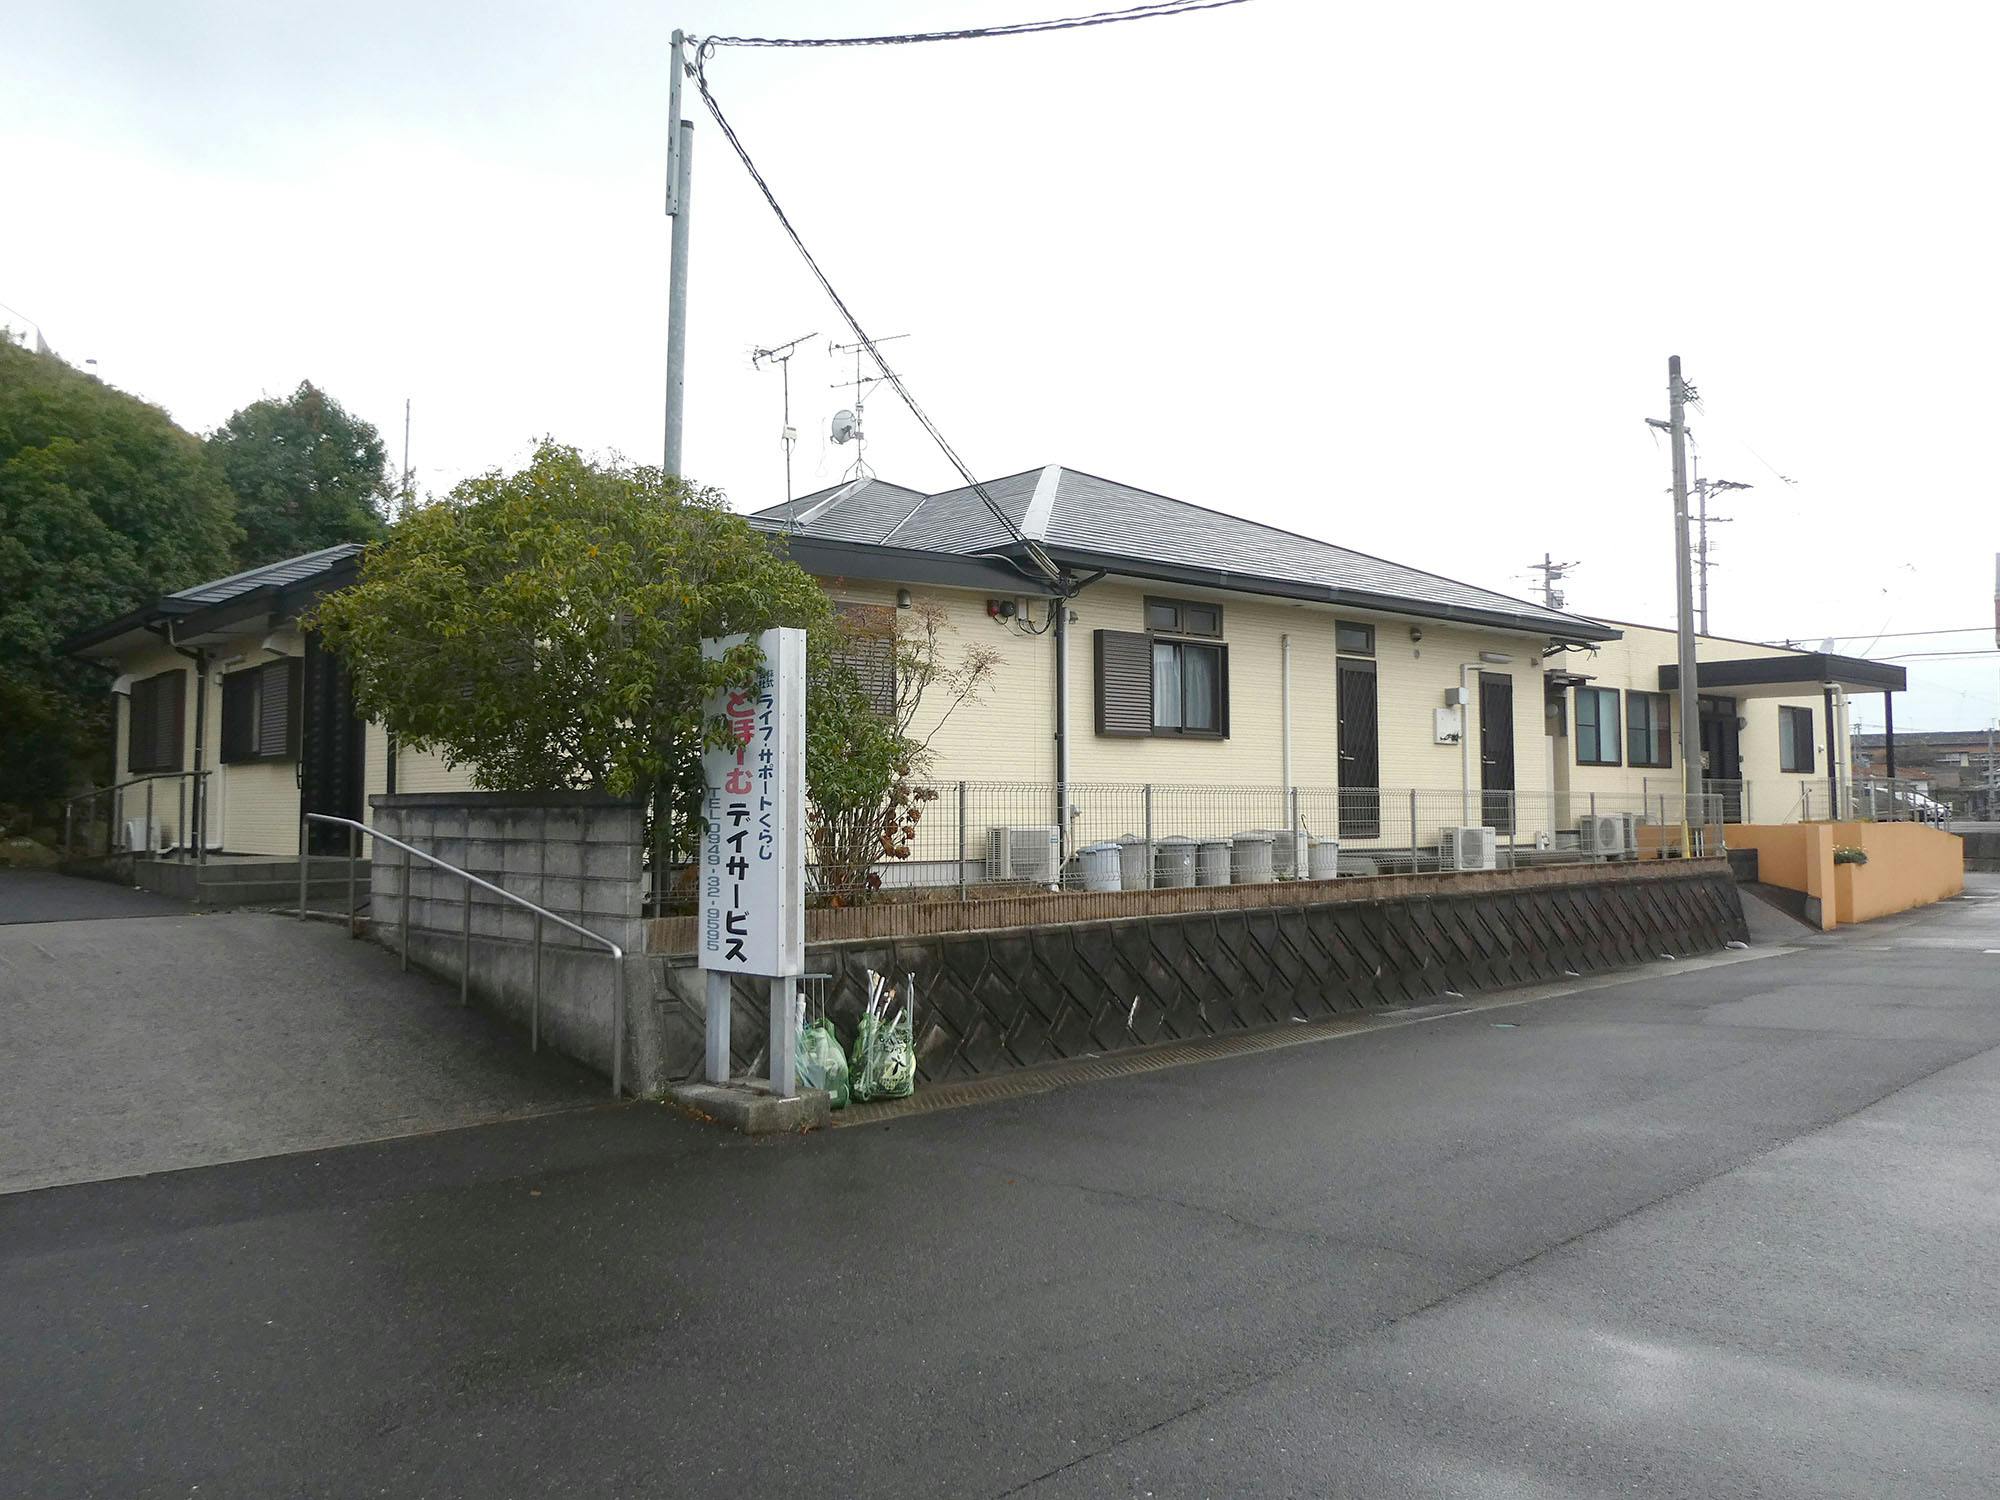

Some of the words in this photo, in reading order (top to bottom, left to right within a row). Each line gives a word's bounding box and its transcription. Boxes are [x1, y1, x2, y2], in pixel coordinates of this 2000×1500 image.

[725, 803, 750, 963] デイサービス
